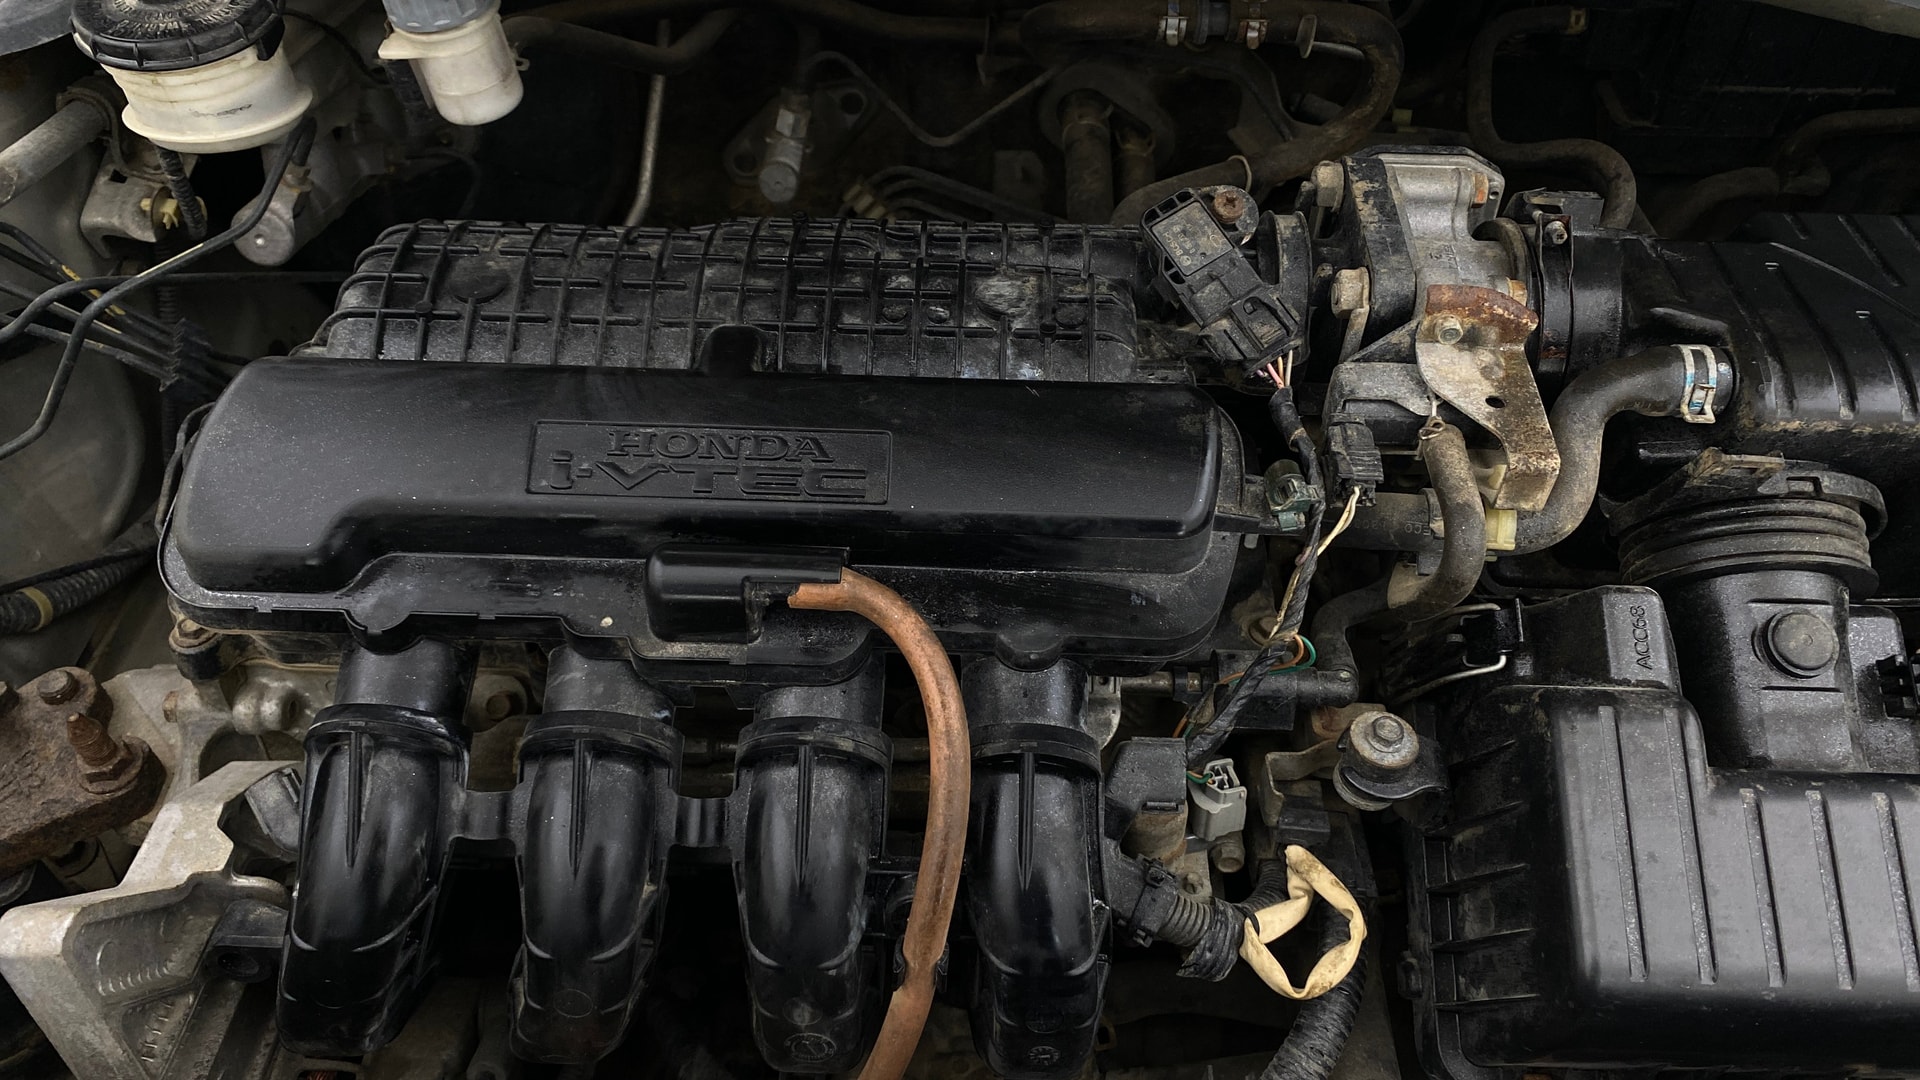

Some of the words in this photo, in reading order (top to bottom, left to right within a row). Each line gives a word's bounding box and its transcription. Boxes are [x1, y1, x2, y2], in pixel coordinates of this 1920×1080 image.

[607, 430, 834, 463] HONDA
[550, 449, 868, 499] i-VTEC
[1629, 605, 1653, 670] ACC68
